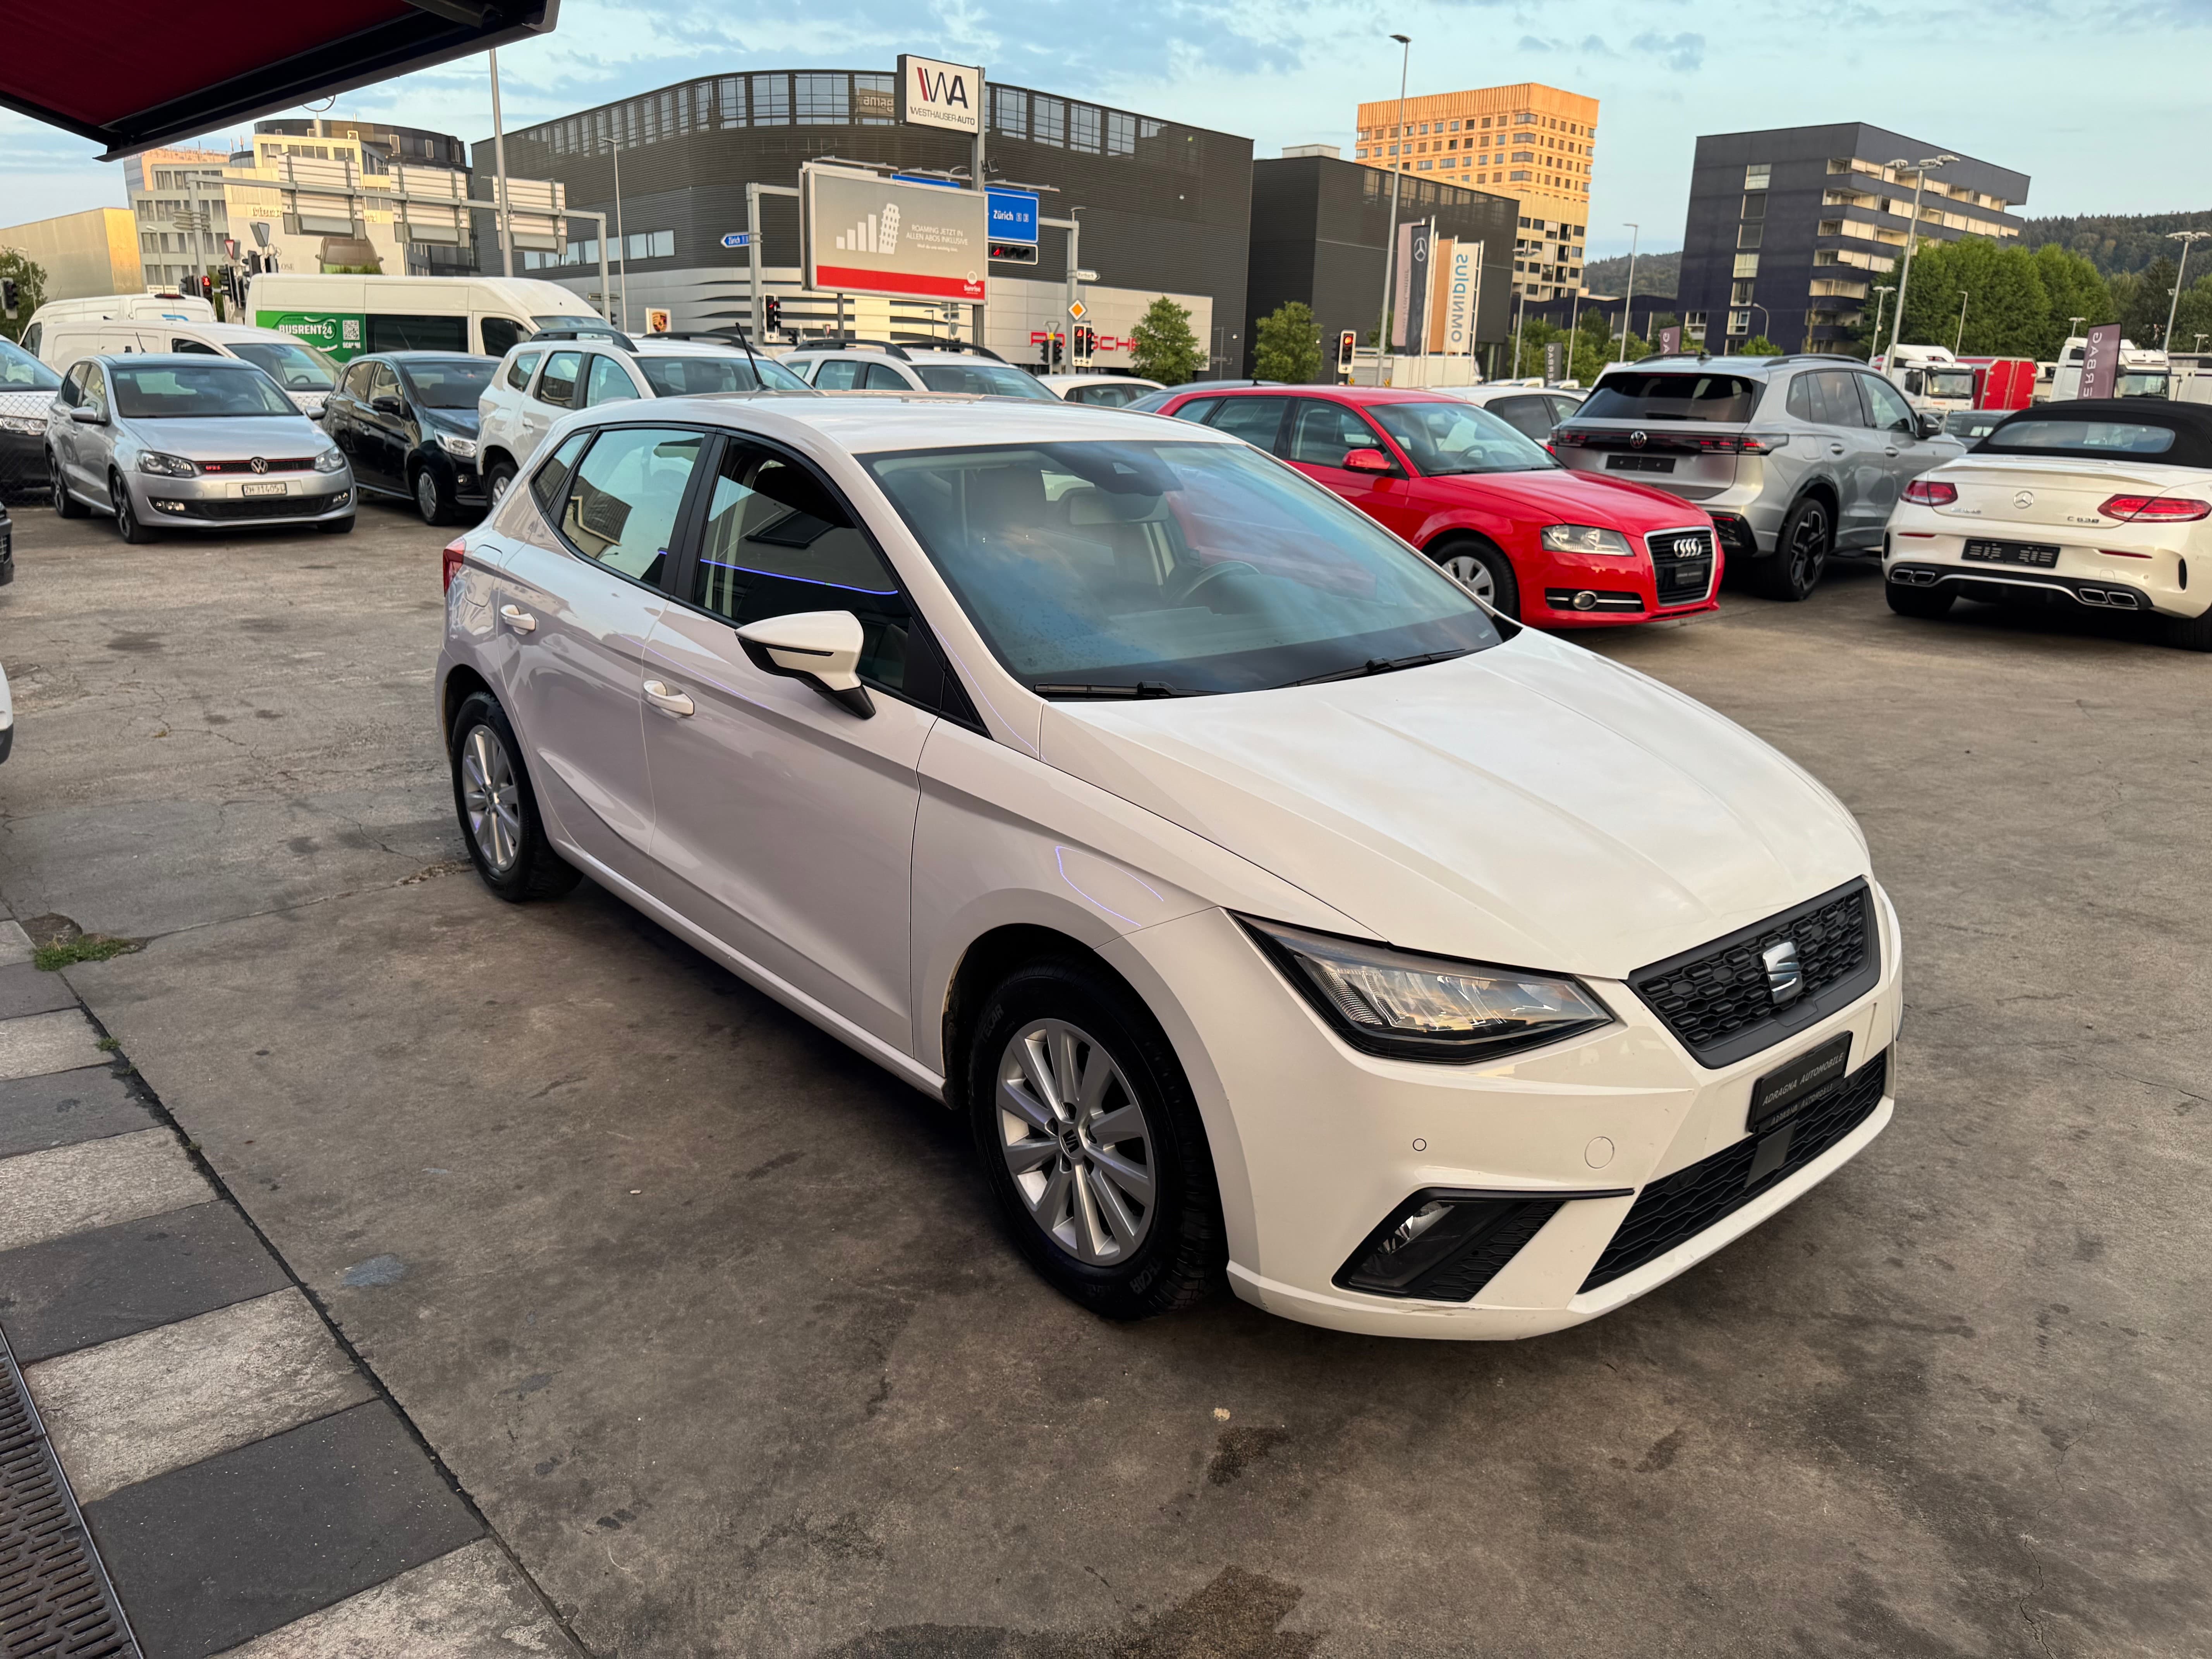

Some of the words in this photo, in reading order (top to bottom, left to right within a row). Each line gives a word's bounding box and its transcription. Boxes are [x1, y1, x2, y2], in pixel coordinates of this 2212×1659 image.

[863, 96, 894, 112] amag
[993, 210, 1013, 221] Zürich
[912, 224, 939, 234] ROAMING
[940, 228, 956, 236] JETZT
[906, 232, 924, 240] ALLEN
[925, 234, 940, 242] ABOS
[941, 236, 969, 246] INKLUSIVE
[279, 323, 332, 335] BUSRENT24
[1762, 1079, 1797, 1106] ADRAGNA
[1800, 1052, 1844, 1085] AUTOMOBILE
